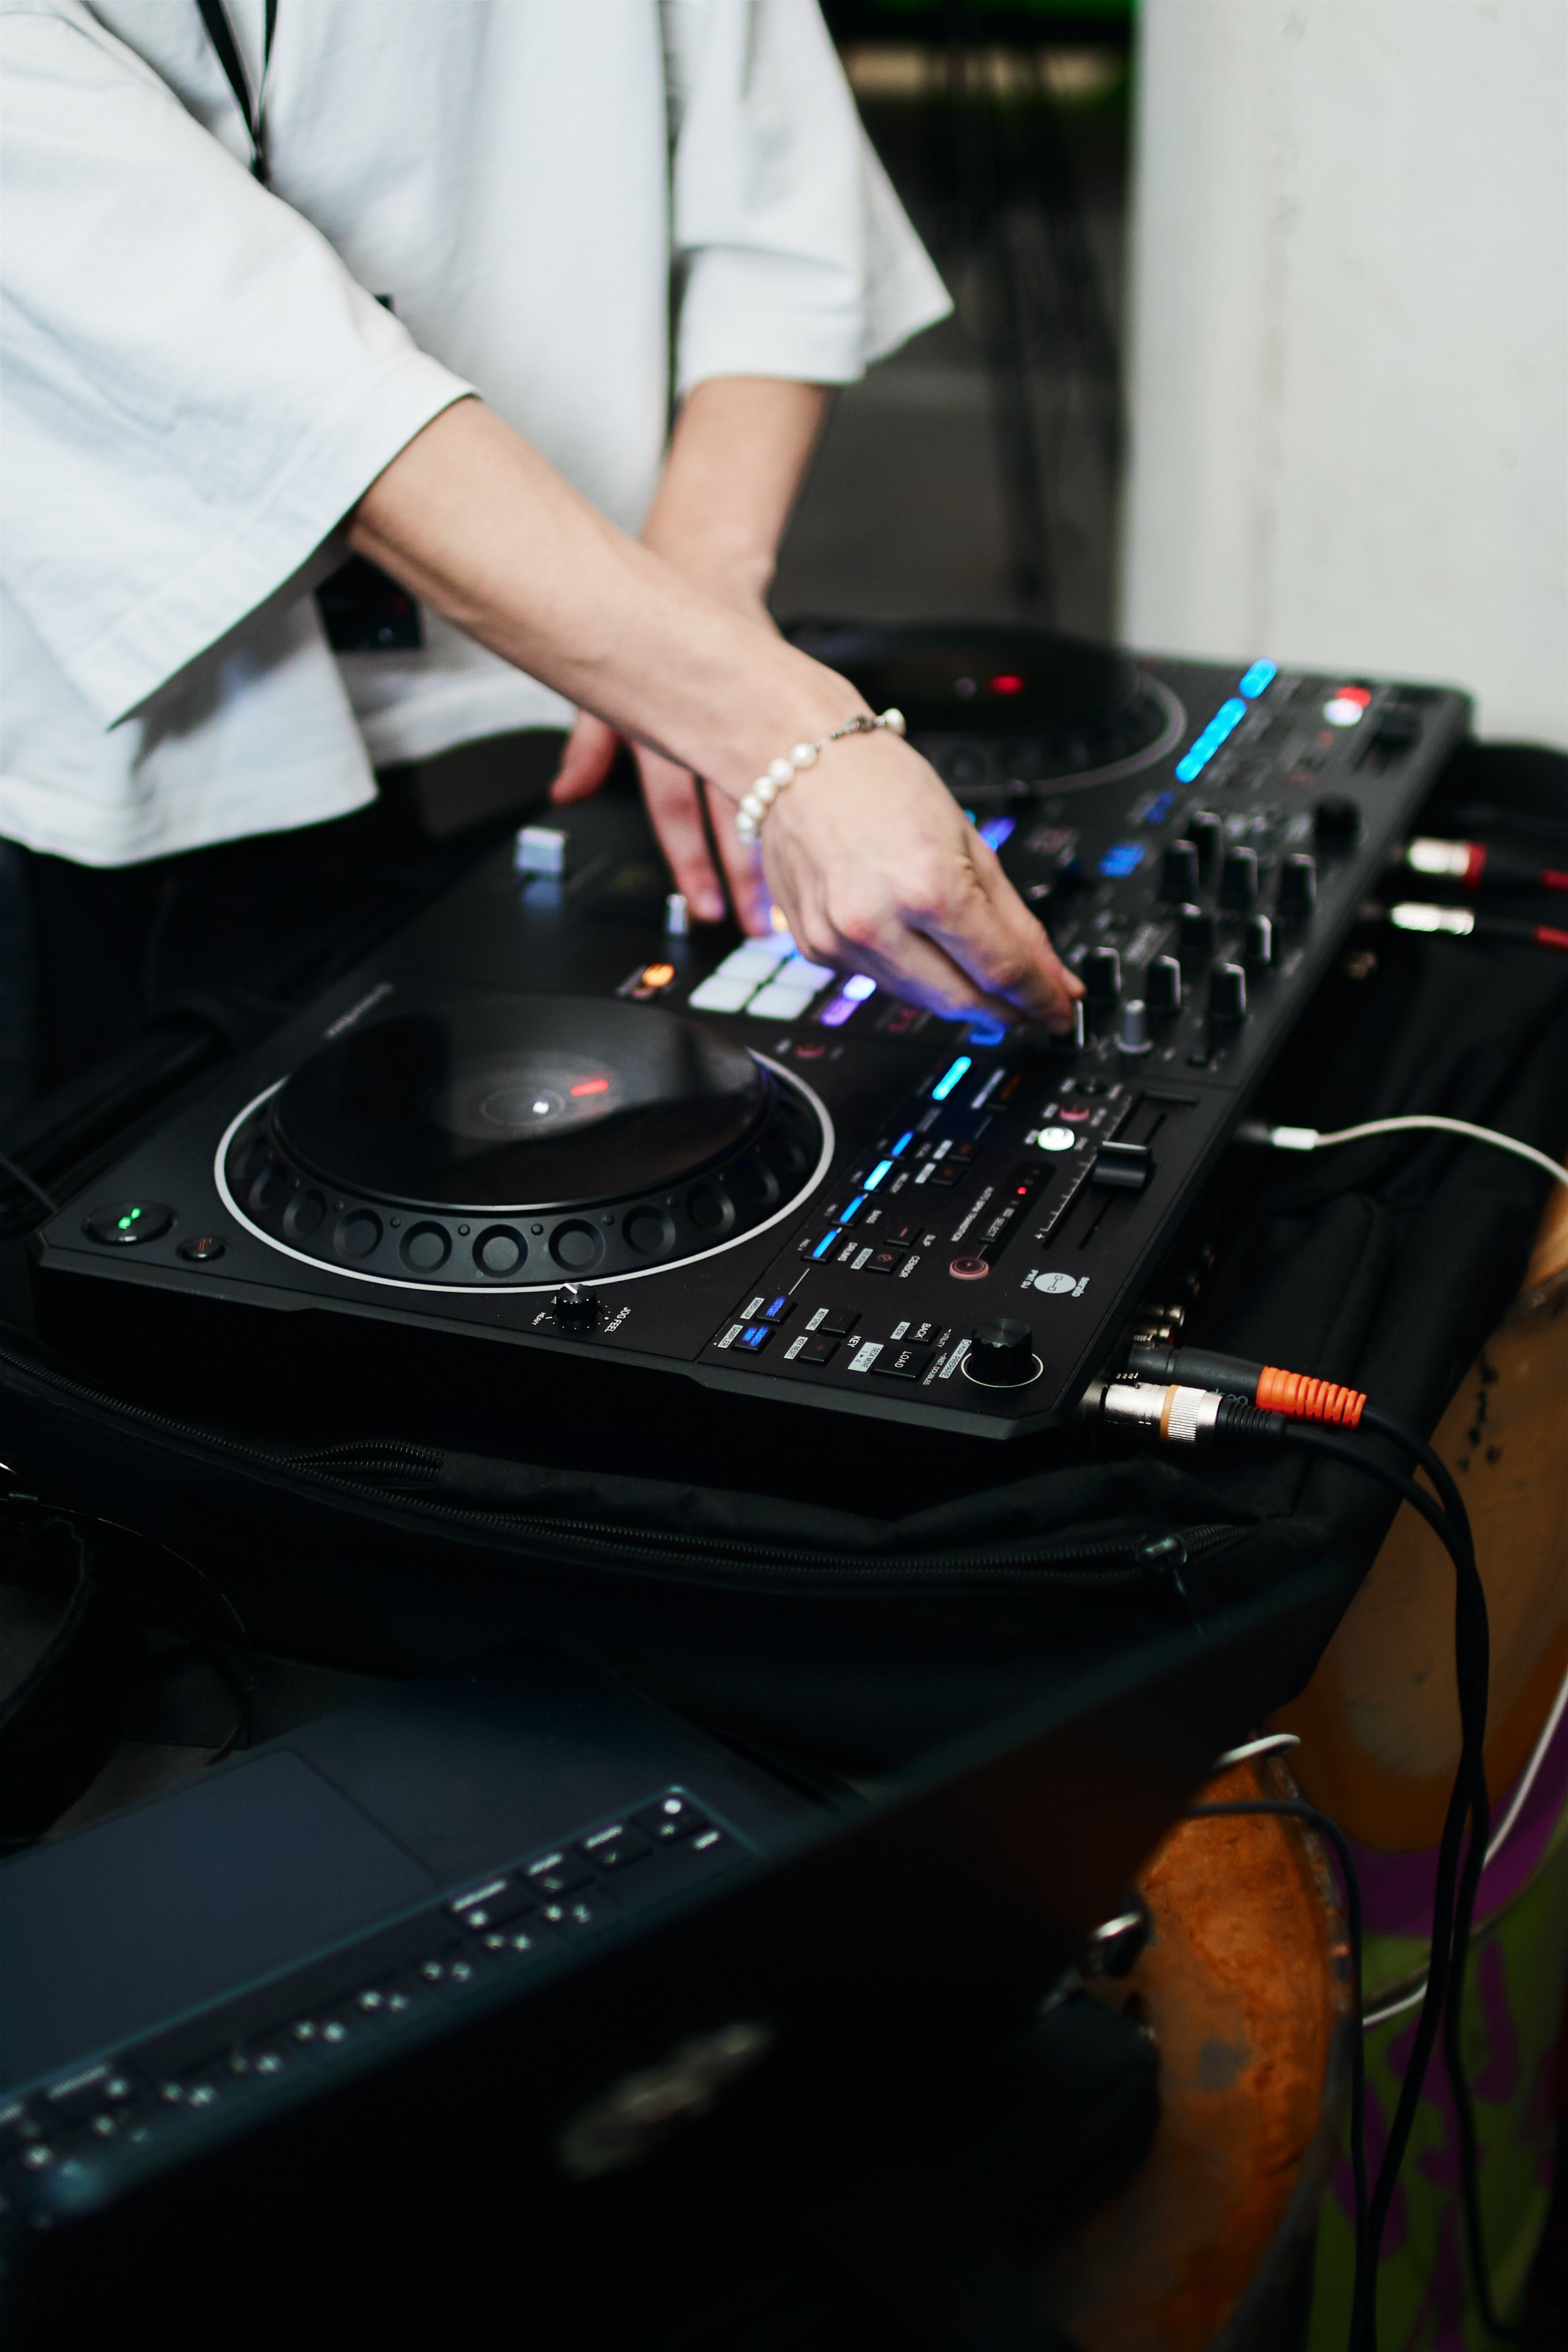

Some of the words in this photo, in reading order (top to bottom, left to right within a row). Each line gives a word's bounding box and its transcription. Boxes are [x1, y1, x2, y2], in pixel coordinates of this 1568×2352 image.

[987, 1217, 1006, 1237] SELECT
[837, 1242, 858, 1262] DRUMS
[899, 1255, 921, 1277] CENSOR
[1021, 1280, 1032, 1289] DJ
[531, 1312, 547, 1326] HEAVY
[617, 1307, 631, 1319] JOG
[604, 1319, 623, 1333] FEEL
[809, 1317, 821, 1328] SYNC
[720, 1326, 741, 1346] SAMPLER
[894, 1325, 907, 1337] VIEW
[915, 1322, 932, 1338] BACK
[847, 1335, 862, 1348] KEY
[937, 1333, 950, 1348] UTILITY
[788, 1344, 801, 1358] RESET
[870, 1347, 881, 1358] DECK
[861, 1356, 873, 1369] MOVE
[894, 1351, 912, 1368] LOAD
[941, 1355, 961, 1377] PREPARE
[923, 1366, 940, 1385] DOUBLES
